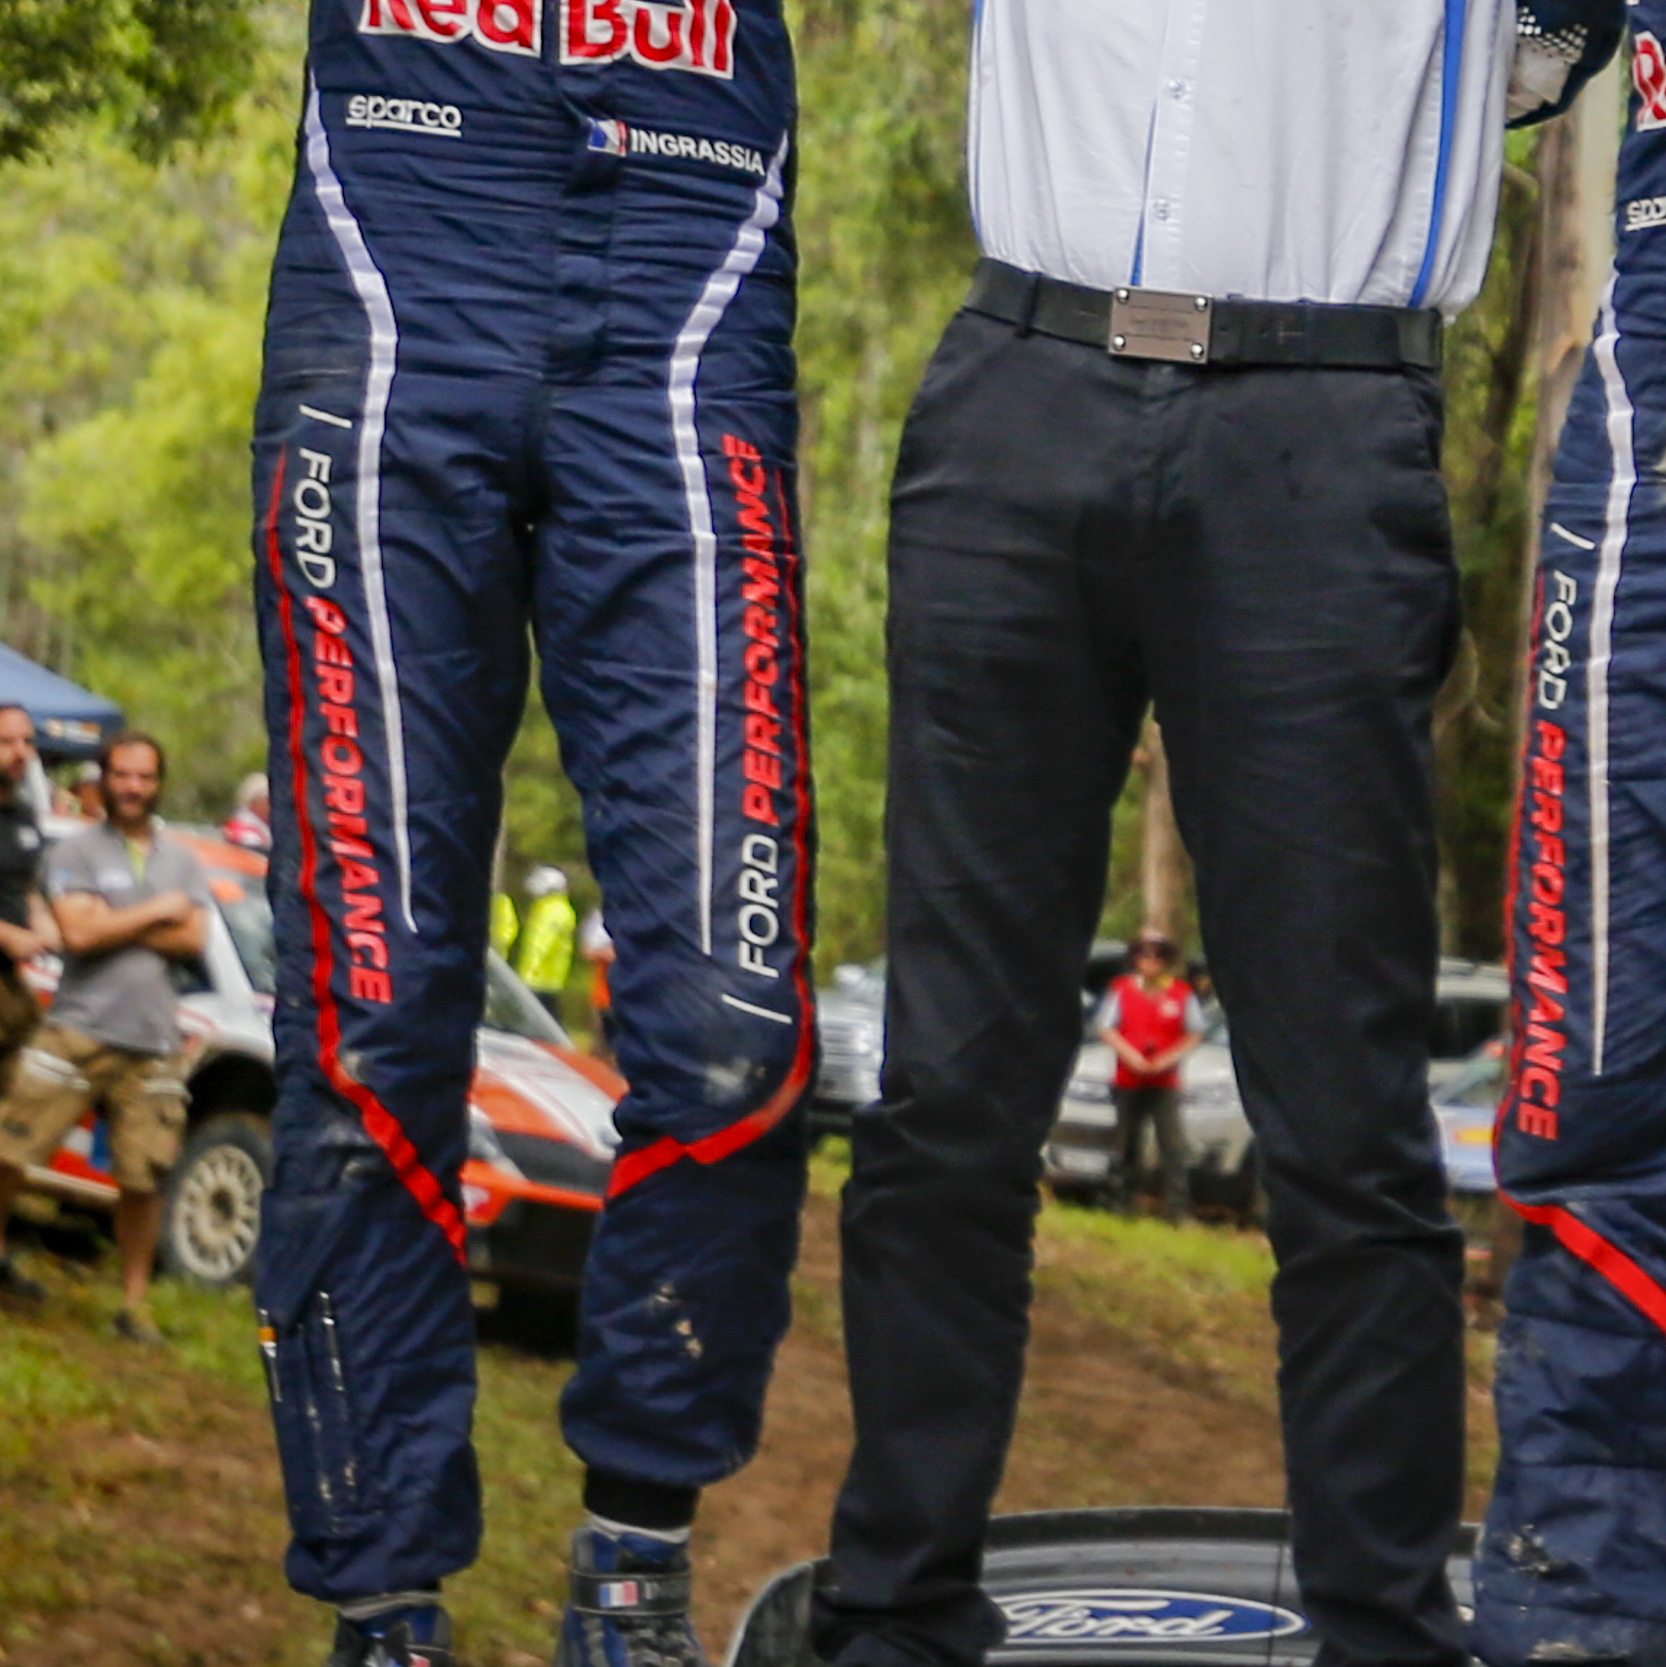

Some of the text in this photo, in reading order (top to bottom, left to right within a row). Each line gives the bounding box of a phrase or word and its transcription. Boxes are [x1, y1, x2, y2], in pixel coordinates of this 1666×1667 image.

[346, 94, 463, 135] sparco
[631, 128, 766, 176] INGRASSIA
[292, 447, 392, 1005] FORD PERFORMANCE
[722, 434, 782, 977] FORD PERFORMANCE
[1517, 569, 1577, 1141] FORD PERFORMANCE
[1002, 1598, 1234, 1637] Ford
